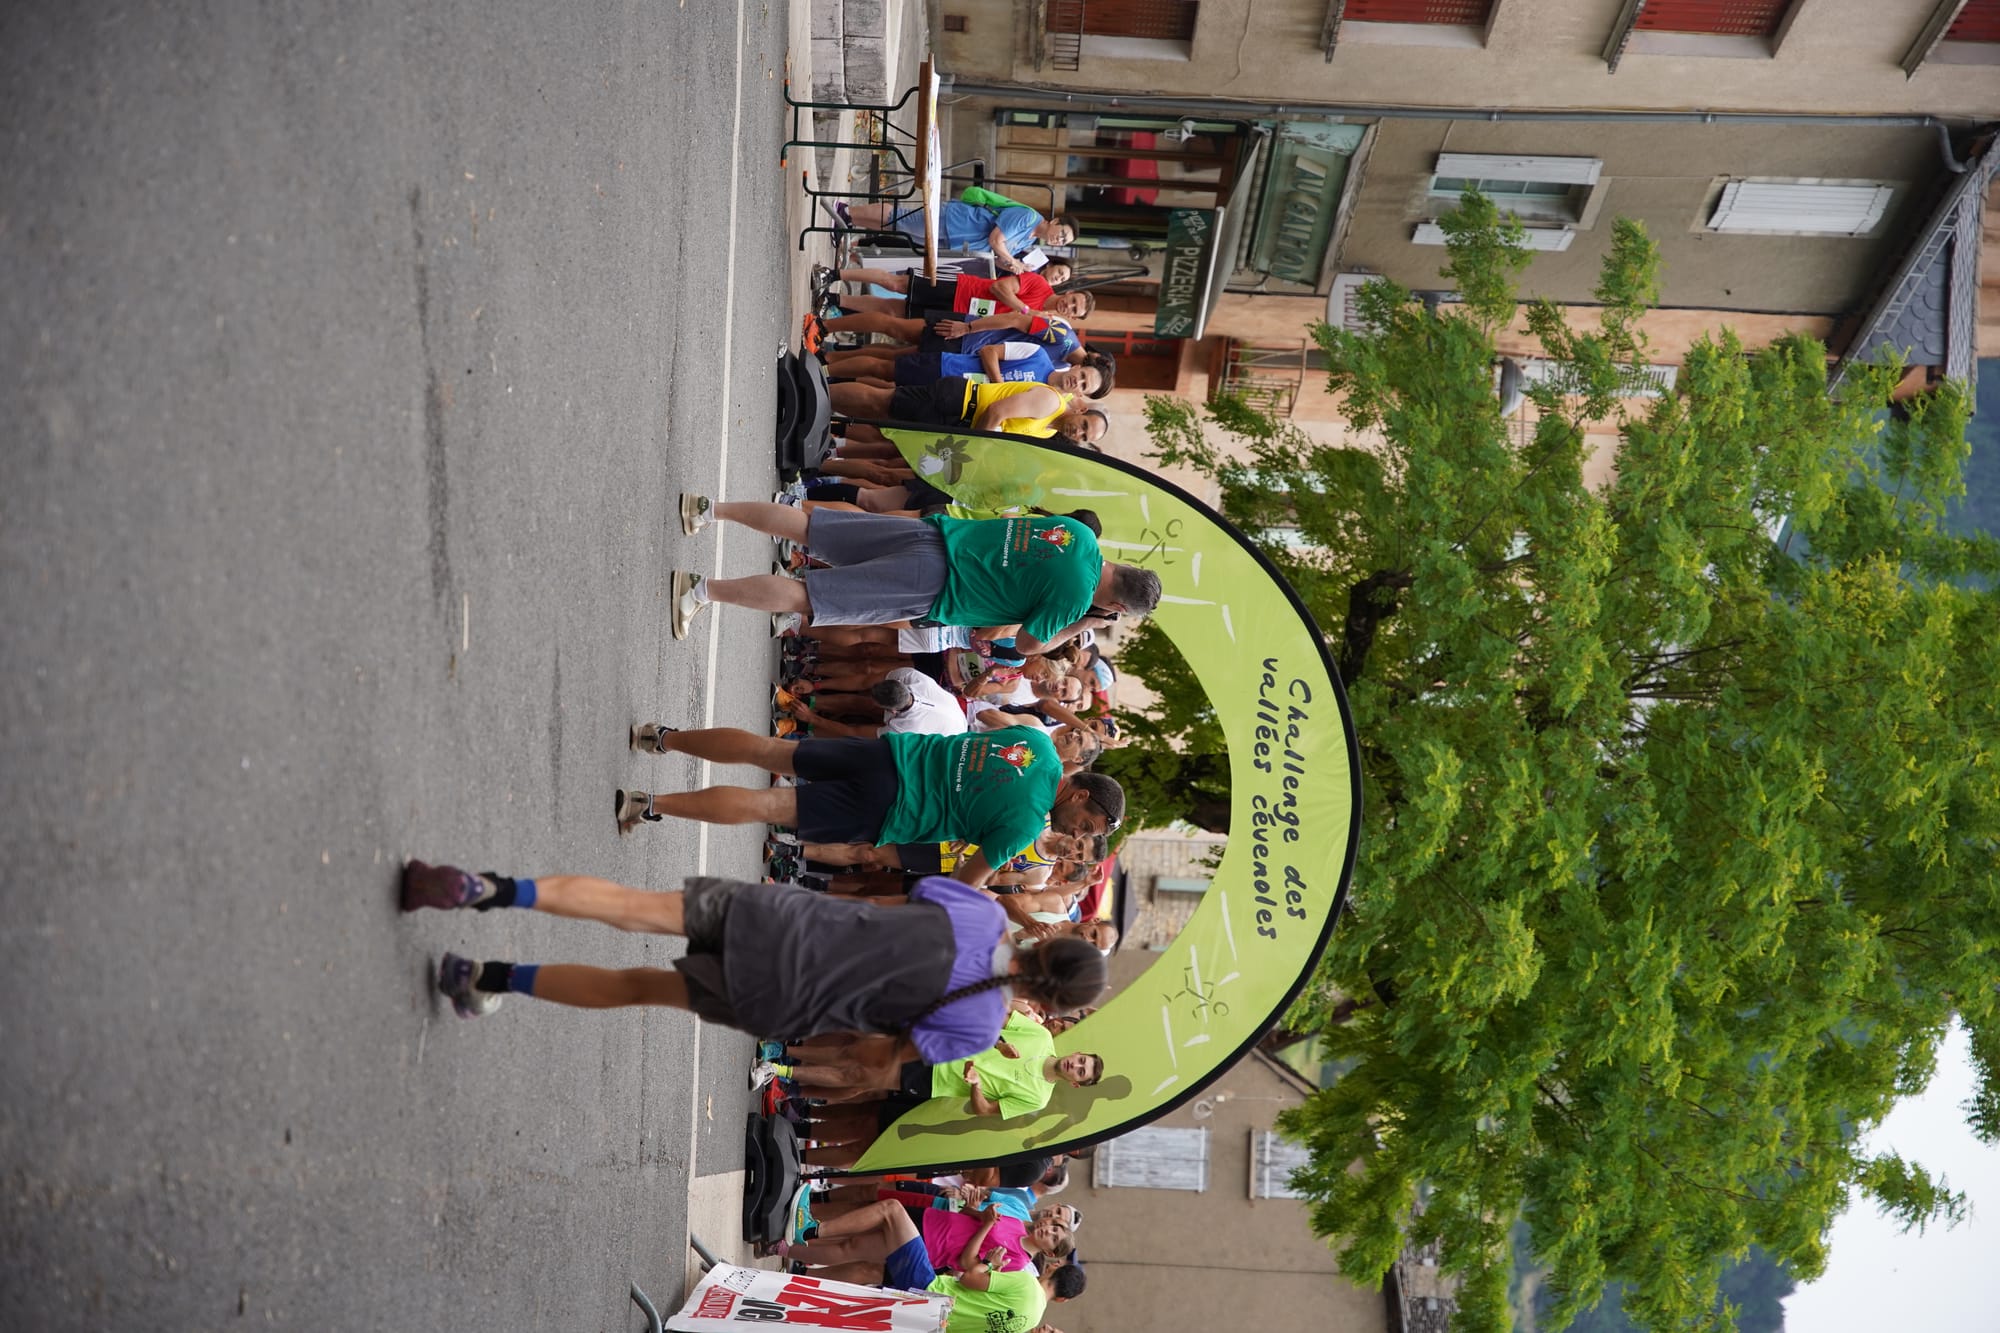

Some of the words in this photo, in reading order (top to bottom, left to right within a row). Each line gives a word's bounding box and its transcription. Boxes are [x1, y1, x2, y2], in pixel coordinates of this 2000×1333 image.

[1166, 246, 1201, 307] PIZZERIA
[1254, 658, 1280, 774] vallées
[1273, 678, 1312, 844] Challenge
[1252, 794, 1278, 940] cévenoles
[1284, 864, 1307, 920] des
